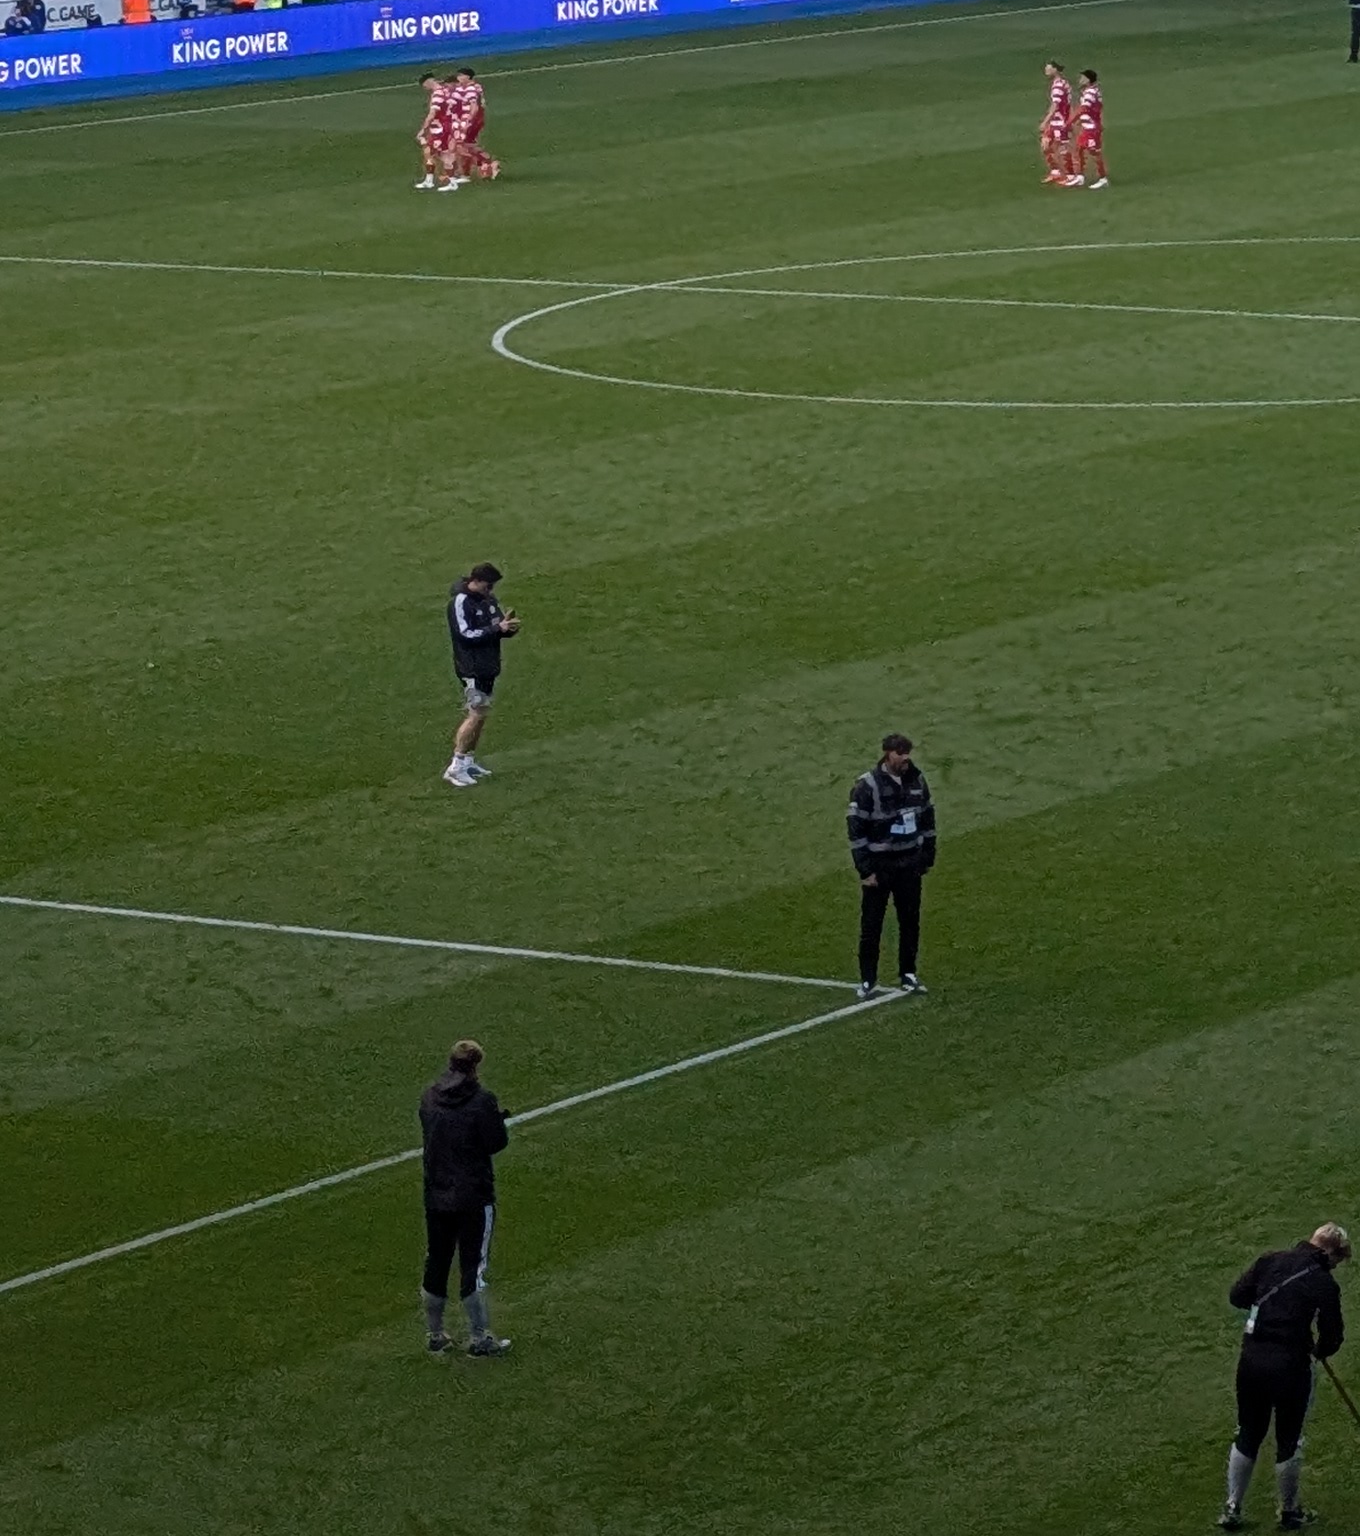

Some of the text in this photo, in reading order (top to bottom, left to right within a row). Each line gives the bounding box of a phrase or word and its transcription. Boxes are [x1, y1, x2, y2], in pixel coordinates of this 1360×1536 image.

[372, 12, 481, 41] KING POWER
[172, 31, 289, 64] KING POWER
[14, 53, 82, 82] POWER
